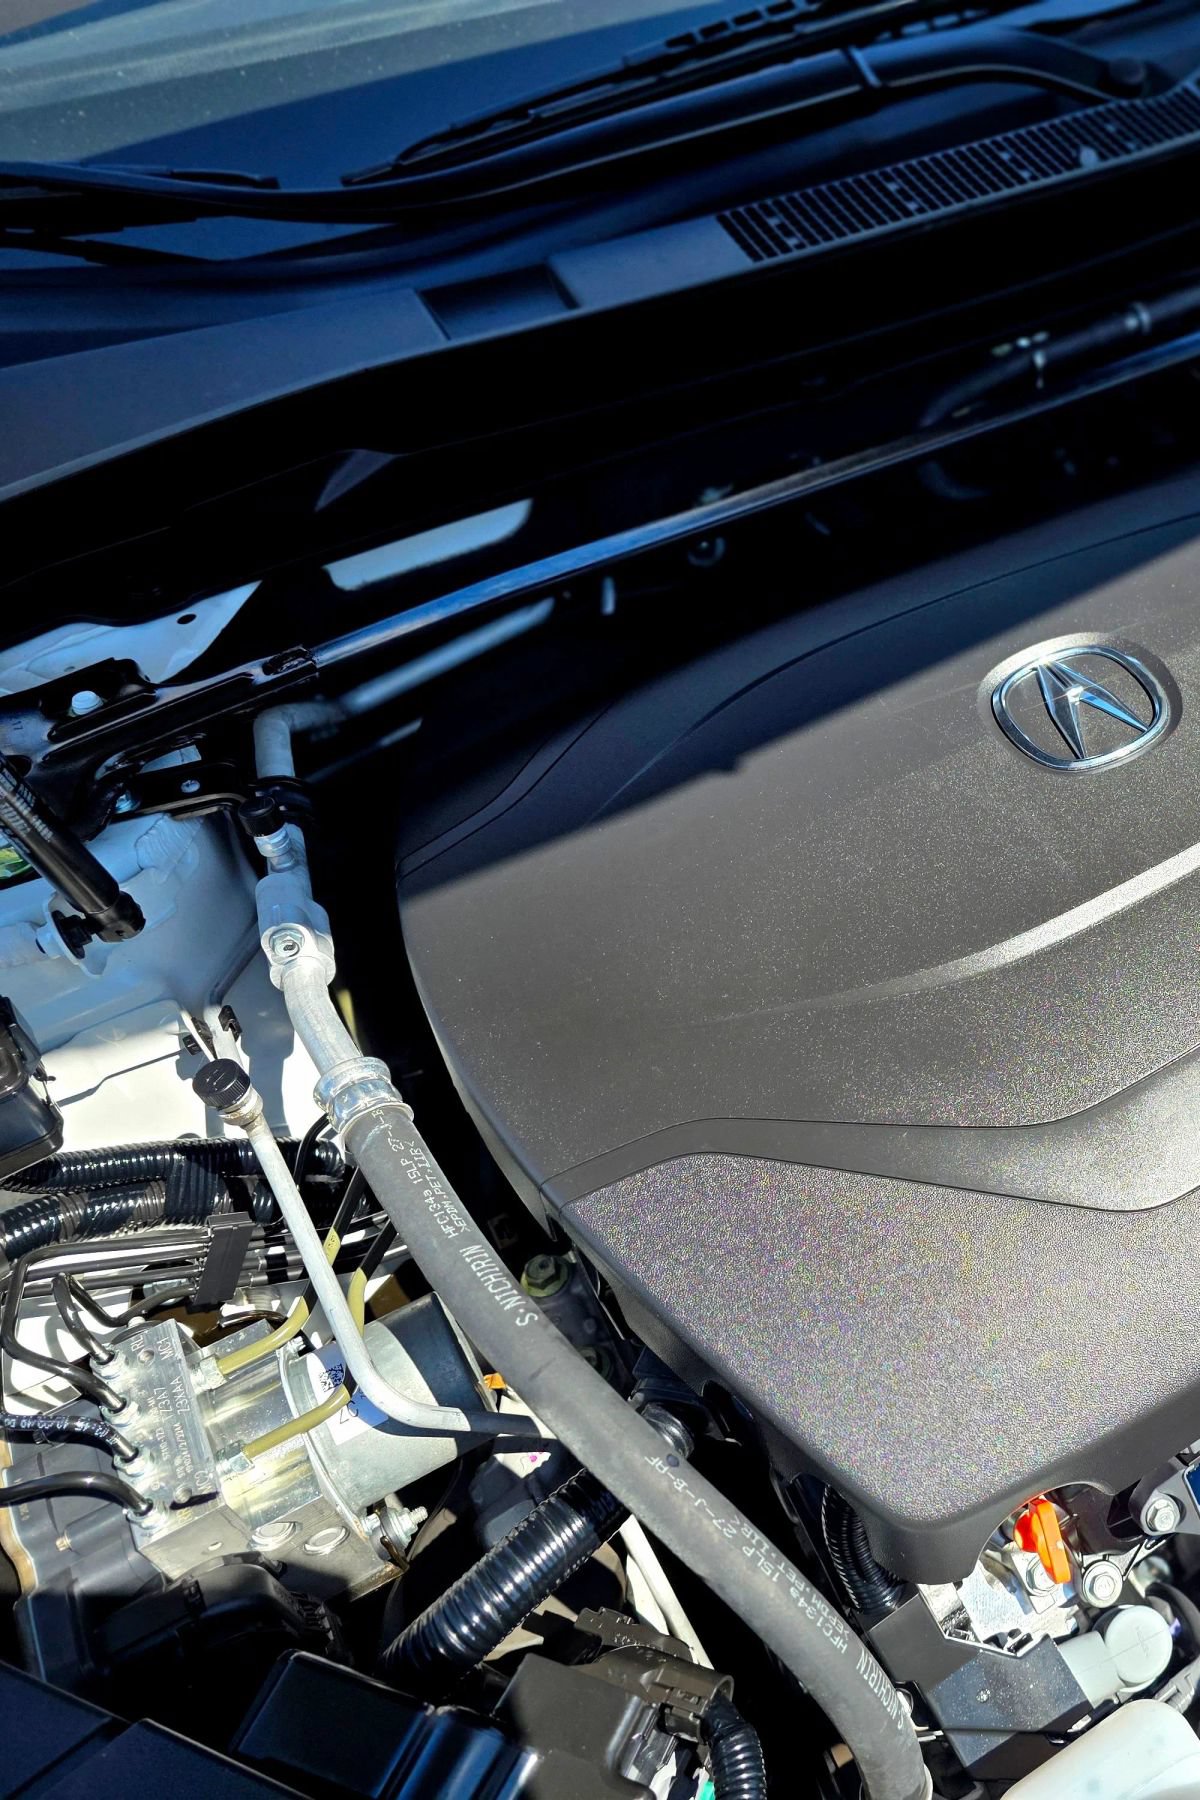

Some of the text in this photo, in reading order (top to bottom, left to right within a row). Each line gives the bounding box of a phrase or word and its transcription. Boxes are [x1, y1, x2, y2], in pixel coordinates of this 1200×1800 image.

[400, 1158, 422, 1184] 15LP
[423, 1189, 459, 1238] HFC134a
[157, 1336, 174, 1360] MC1
[171, 1376, 190, 1415] Z3XAA
[644, 1456, 736, 1539] 27-J-B-AF
[742, 1545, 780, 1583] 15LP
[790, 1587, 848, 1654] HFC134a
